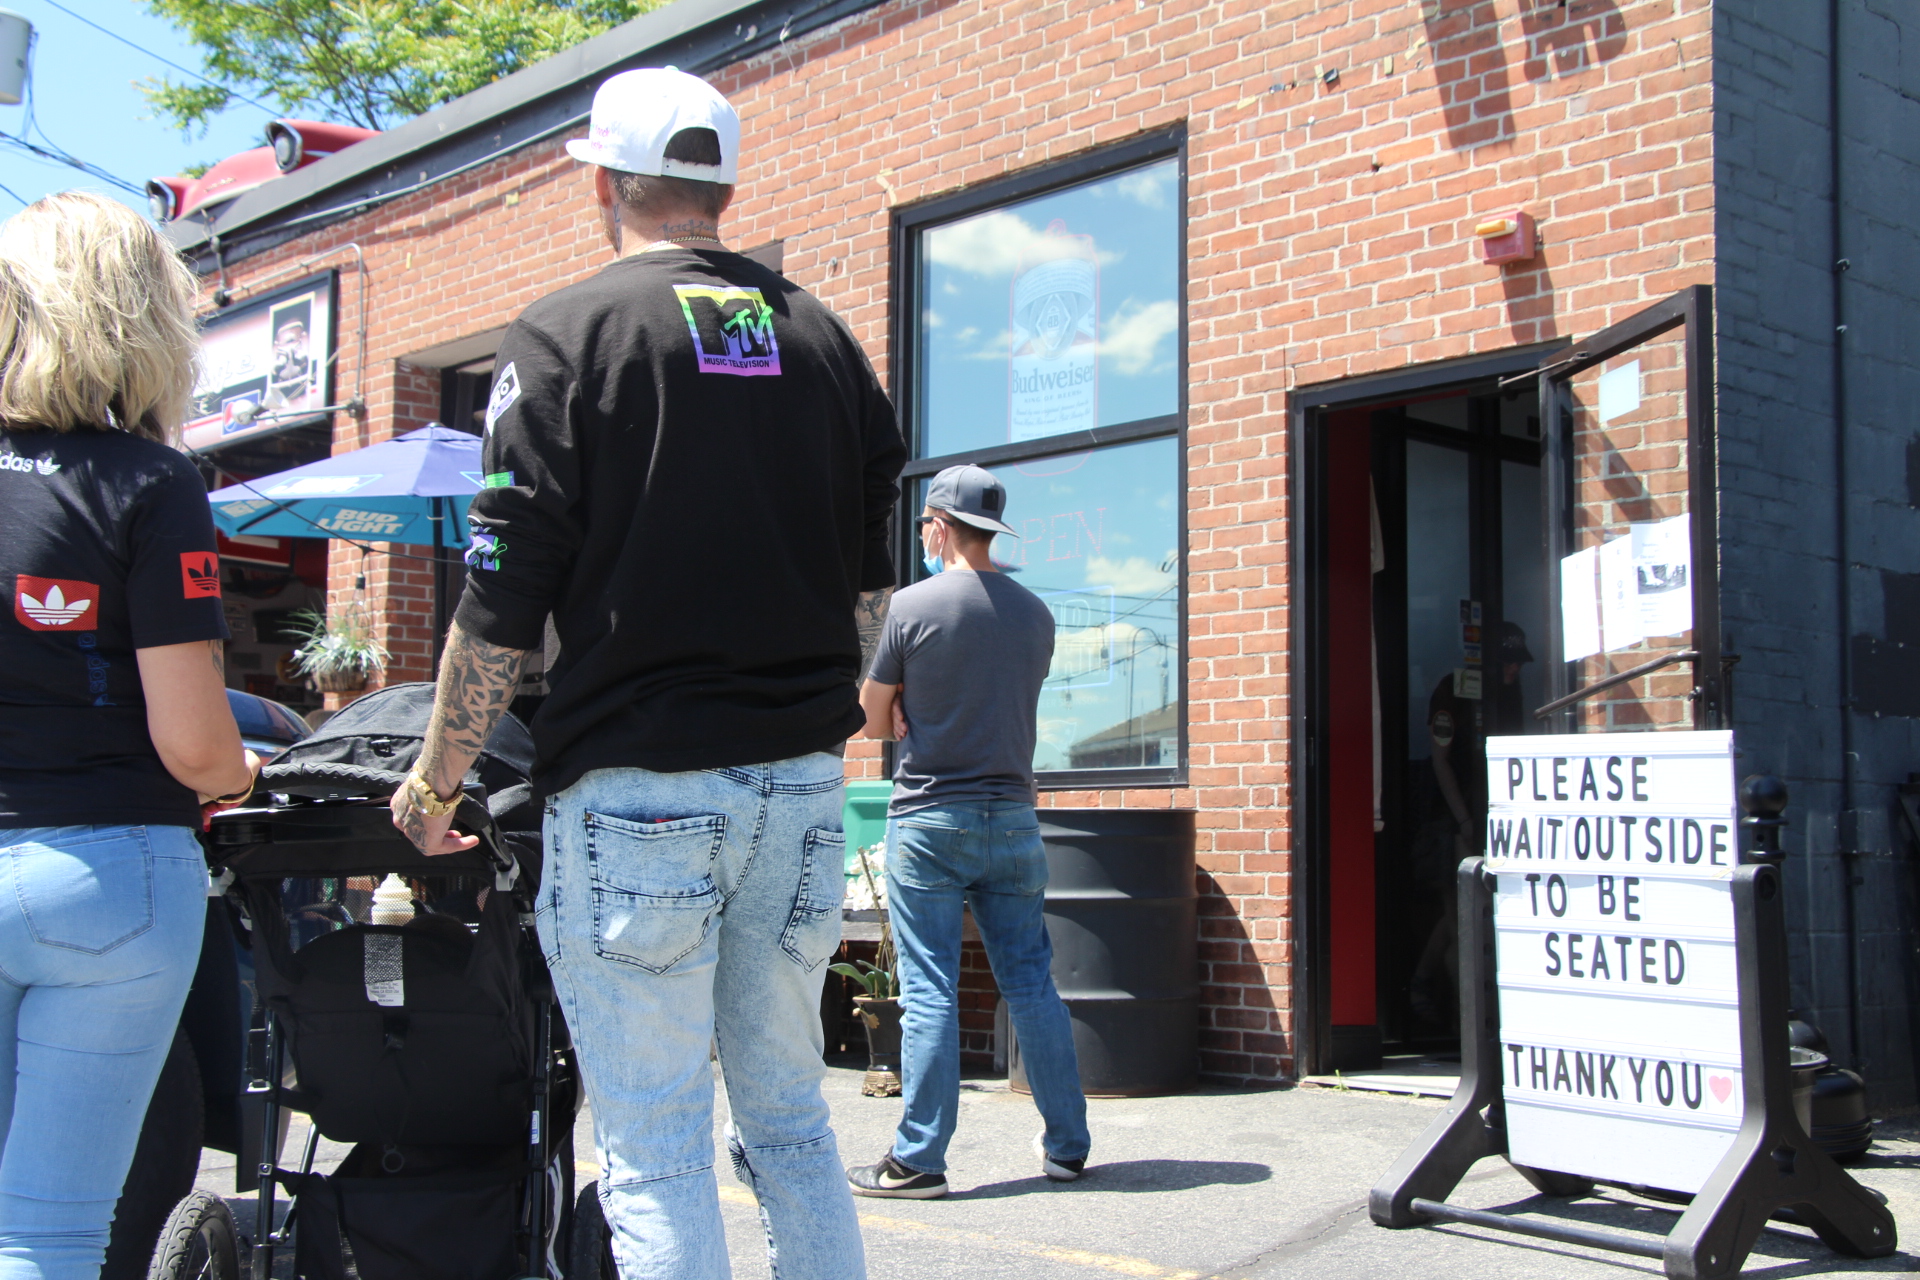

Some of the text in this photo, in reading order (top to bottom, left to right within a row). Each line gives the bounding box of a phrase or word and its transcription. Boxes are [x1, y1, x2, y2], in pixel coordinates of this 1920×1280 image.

[672, 284, 780, 358] MTV
[704, 357, 770, 368] MUSIC TELEVISION
[1012, 362, 1095, 394] Budweiser
[0, 450, 34, 473] das
[315, 518, 404, 535] LIGHT
[334, 508, 399, 523] BUD
[993, 507, 1107, 568] OPEN
[78, 632, 111, 694] adas
[1508, 756, 1648, 801] PLEASE
[1489, 816, 1728, 866] WAIT OUTSIDE
[1525, 873, 1641, 921] TO BE
[1545, 932, 1685, 985] SEATED
[1507, 1044, 1702, 1110] THANK YOU
